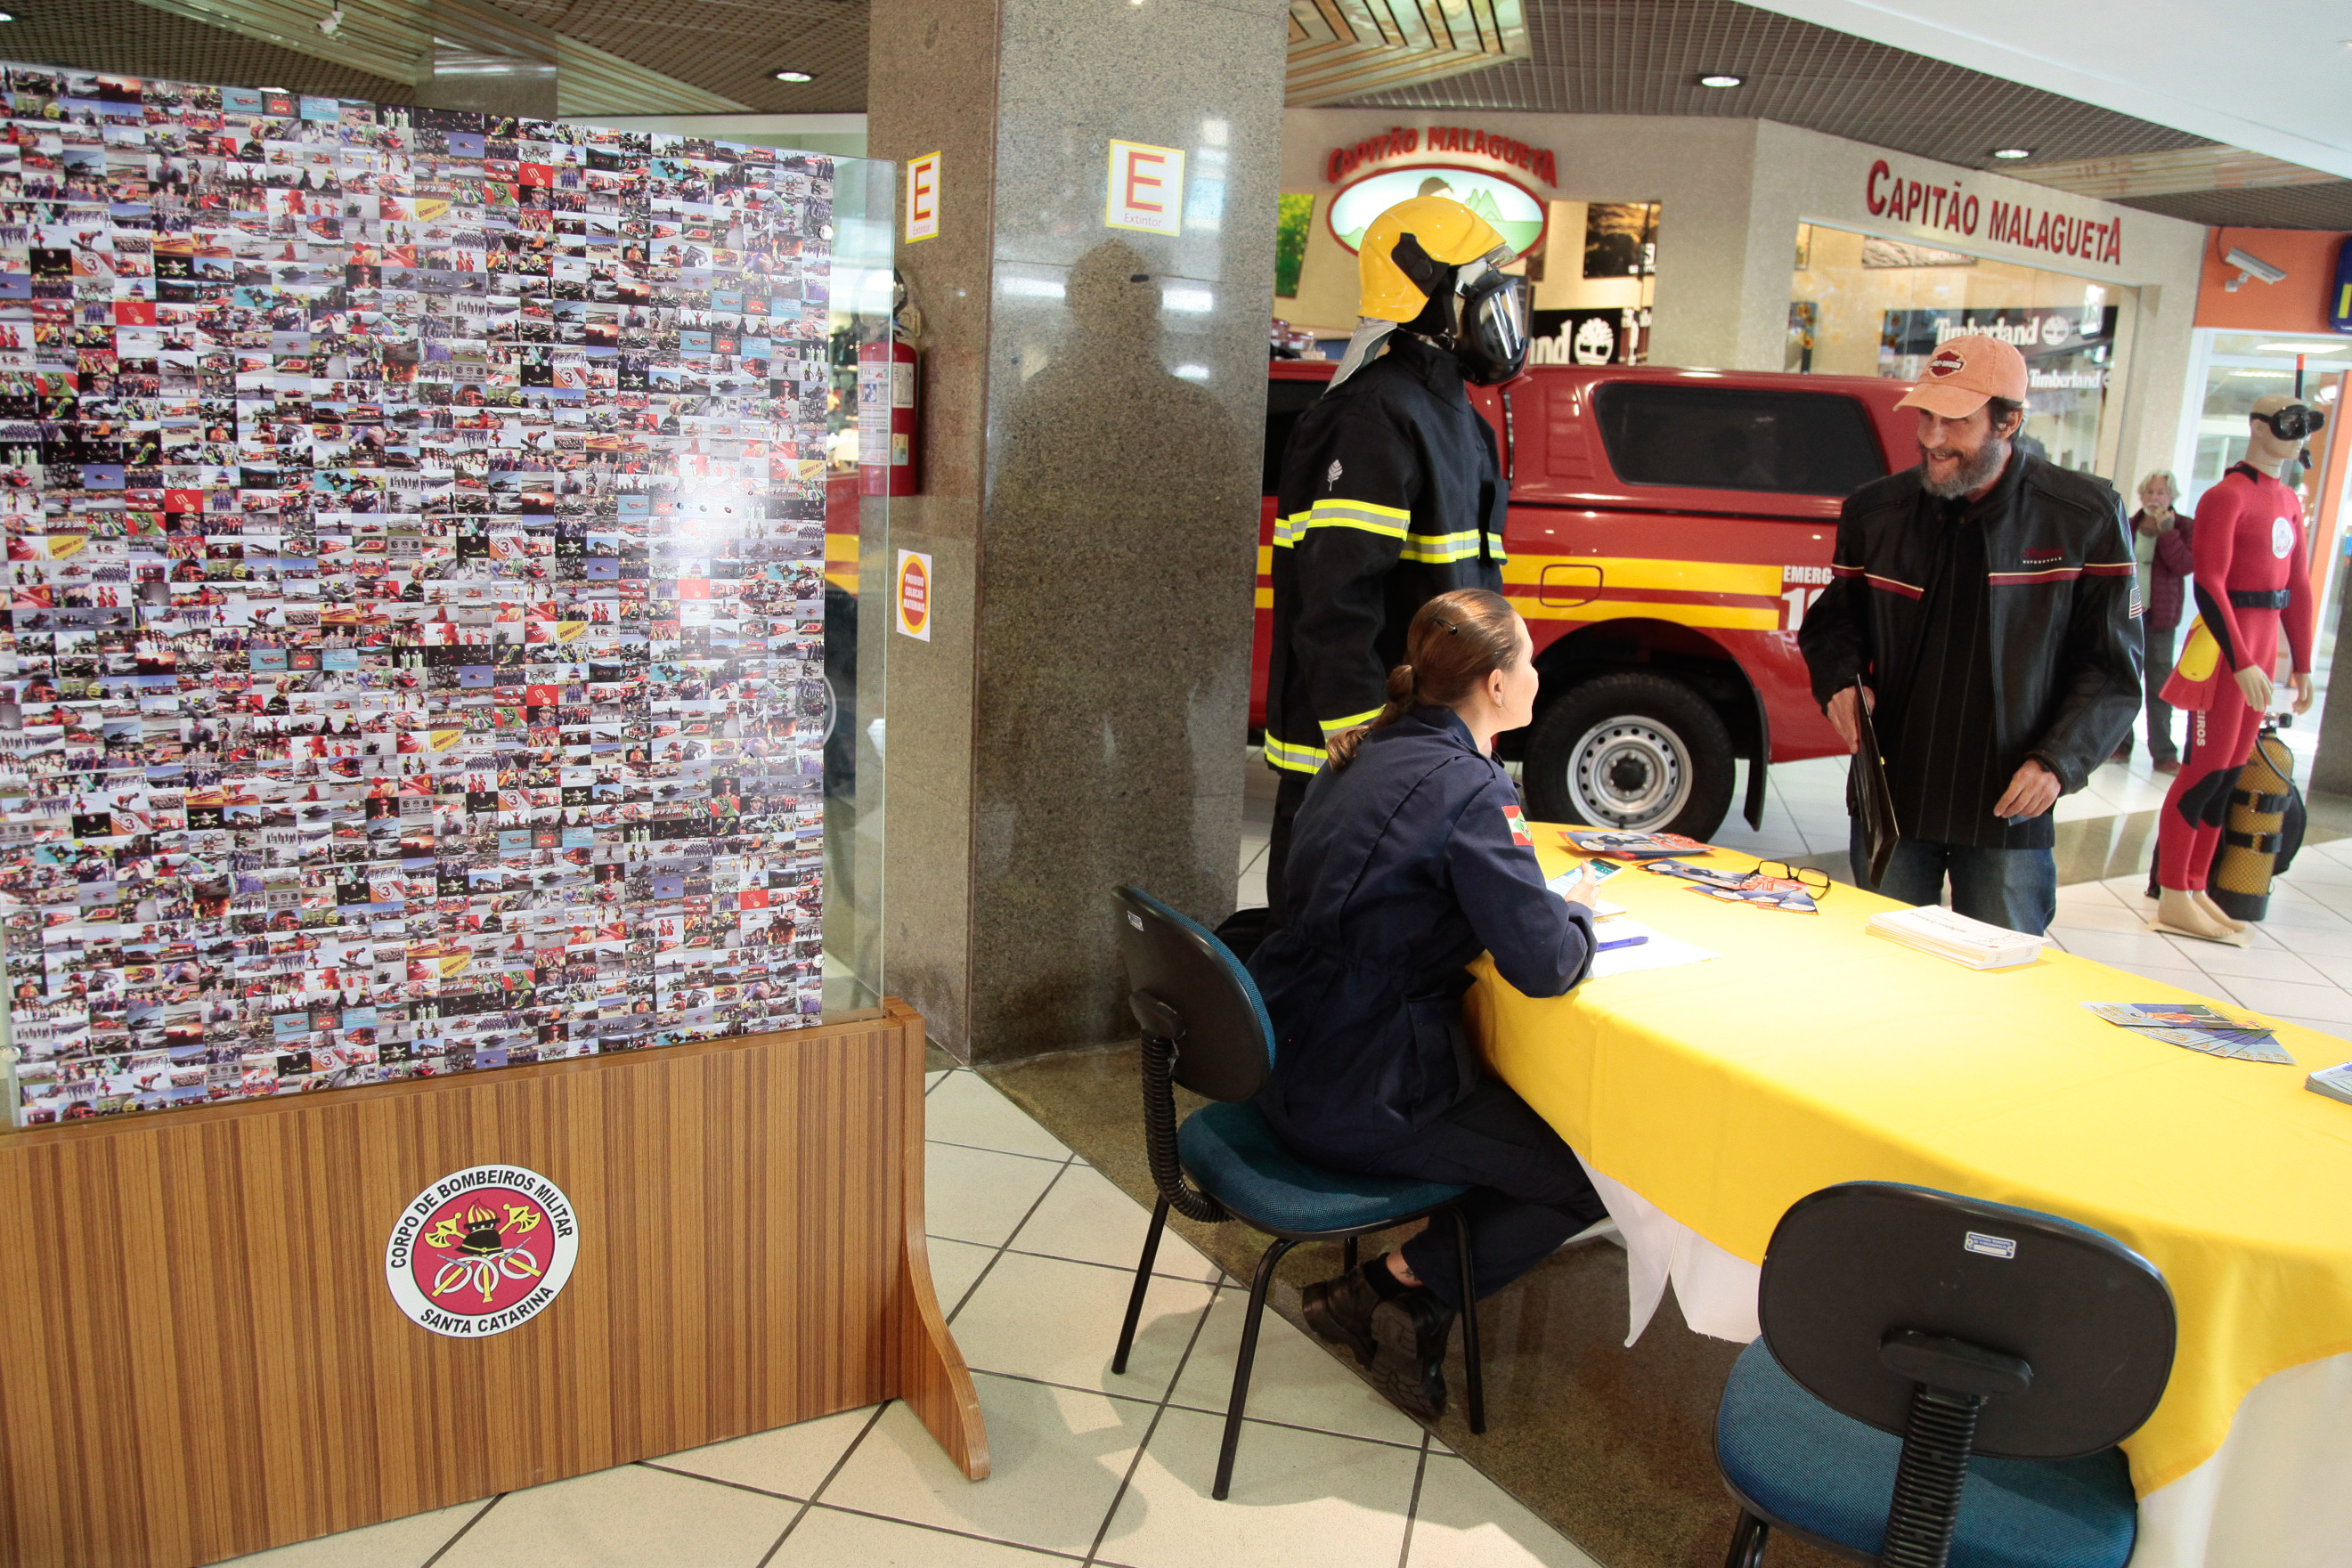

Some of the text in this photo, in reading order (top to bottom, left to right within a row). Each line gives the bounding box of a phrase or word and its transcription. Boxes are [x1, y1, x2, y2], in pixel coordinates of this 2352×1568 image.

[1326, 125, 1558, 189] CAPITÃO MALAGUETA
[1126, 150, 1165, 212] E
[914, 163, 932, 222] E
[1124, 213, 1162, 228] Extintor
[1866, 158, 2121, 265] CAPITÃO MALAGUETA
[913, 223, 932, 235] Extintor
[565, 371, 574, 382] 3
[2030, 369, 2103, 389] Timberland
[501, 541, 509, 553] 3
[1783, 565, 1835, 584] EMERG
[2196, 710, 2206, 747] EIROS
[509, 795, 517, 806] 3
[126, 818, 134, 830] 3
[382, 886, 391, 897] 3
[323, 1055, 332, 1066] 3
[391, 1169, 574, 1269] CORPO DE BOMBEIROS MILITAR
[420, 1286, 554, 1333] SANTA CATARINA
